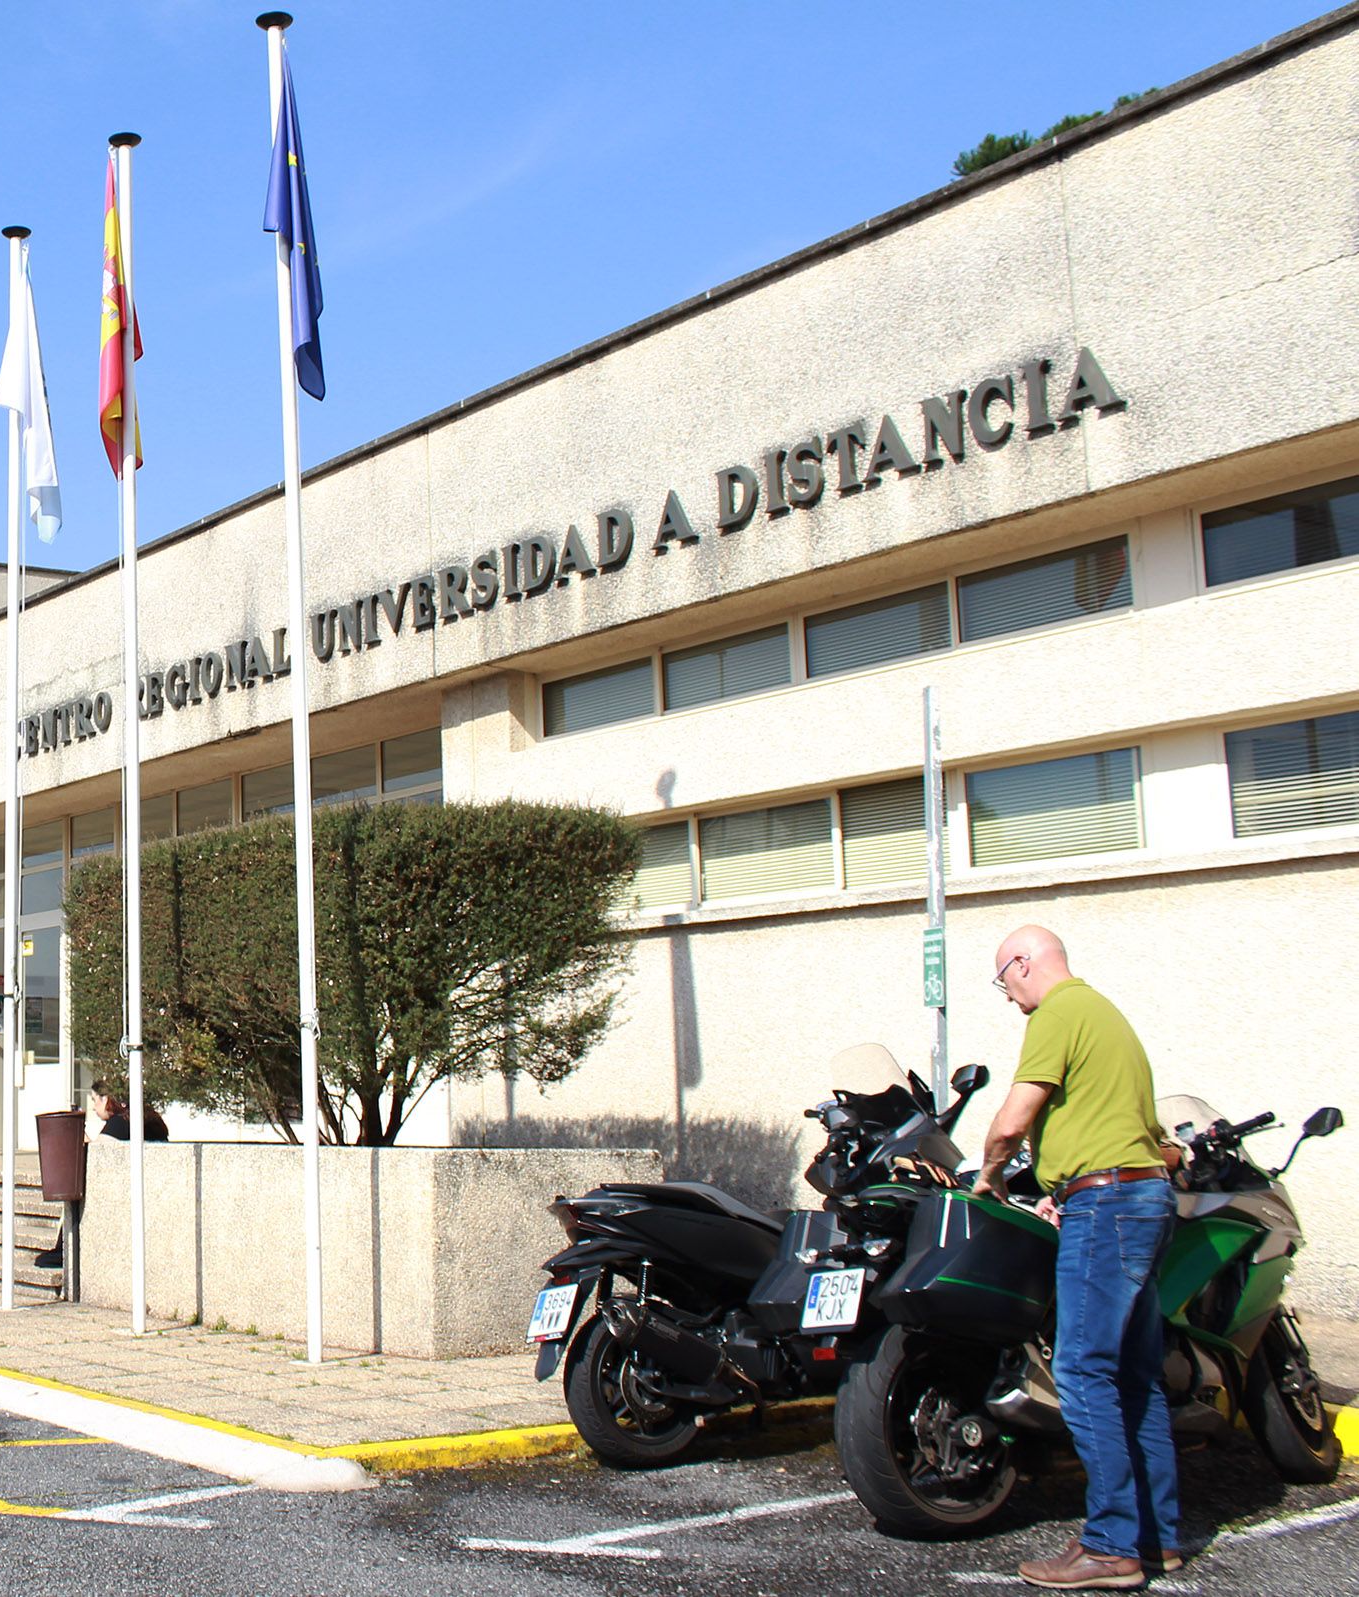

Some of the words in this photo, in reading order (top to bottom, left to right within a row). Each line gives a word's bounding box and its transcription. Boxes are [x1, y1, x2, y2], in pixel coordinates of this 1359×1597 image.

[17, 691, 113, 760] ENTRO
[310, 507, 635, 663] UNIVERSIDAD
[652, 489, 700, 556] A
[715, 346, 1128, 536] DISTANCIA
[819, 1273, 859, 1298] 2504
[544, 1288, 574, 1311] 3694
[815, 1298, 847, 1321] KJX
